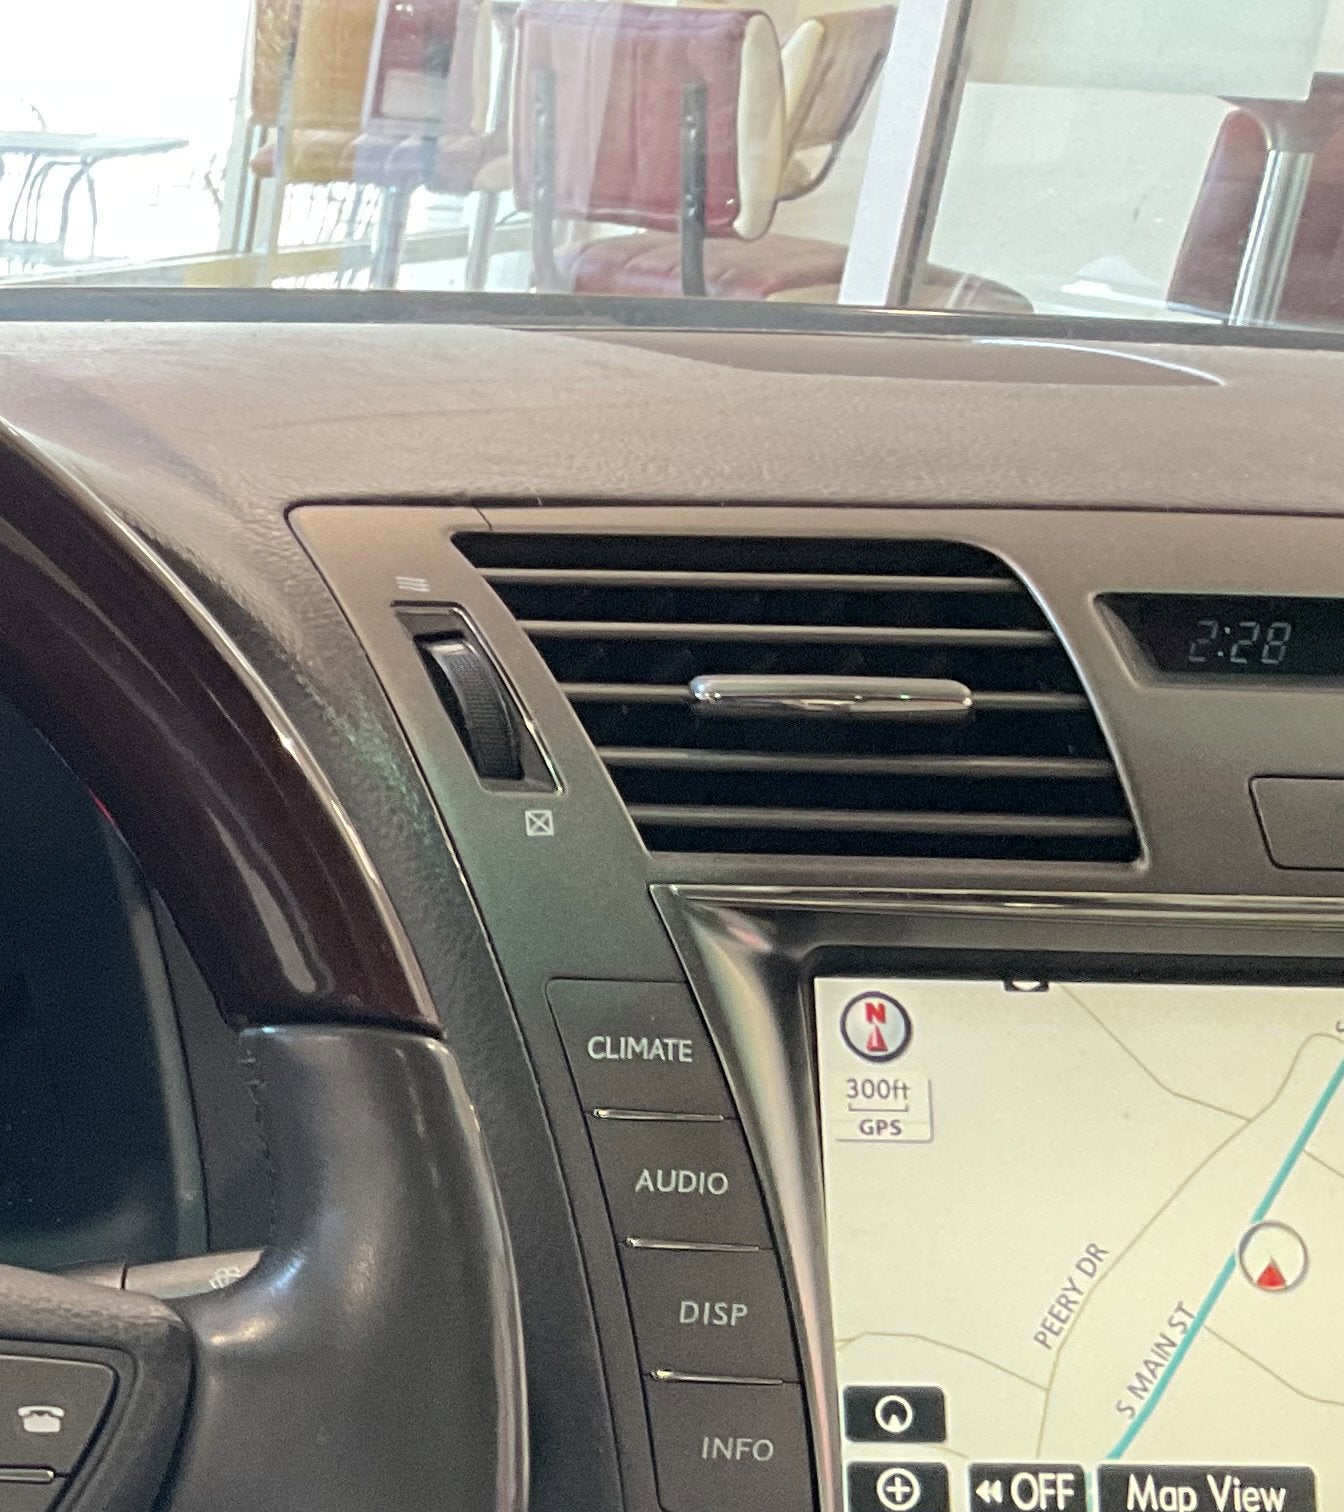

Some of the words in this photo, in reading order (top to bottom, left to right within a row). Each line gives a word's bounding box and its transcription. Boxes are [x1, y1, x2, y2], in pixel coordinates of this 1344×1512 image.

[1189, 620, 1292, 665] 2:28
[865, 1002, 887, 1026] N
[587, 1035, 693, 1063] CLIMATE
[845, 1077, 910, 1101] 300ft
[858, 1118, 903, 1138] GPS
[634, 1168, 729, 1196] AUDIO
[1033, 1277, 1085, 1349] PEERY
[1076, 1242, 1108, 1278] DR
[679, 1301, 749, 1327] DISP
[1117, 1400, 1136, 1421] S
[1127, 1336, 1177, 1401] MAIN
[1168, 1302, 1195, 1334] ST
[700, 1436, 774, 1463] INFO
[1010, 1471, 1075, 1511] OFF
[1206, 1474, 1286, 1512] View
